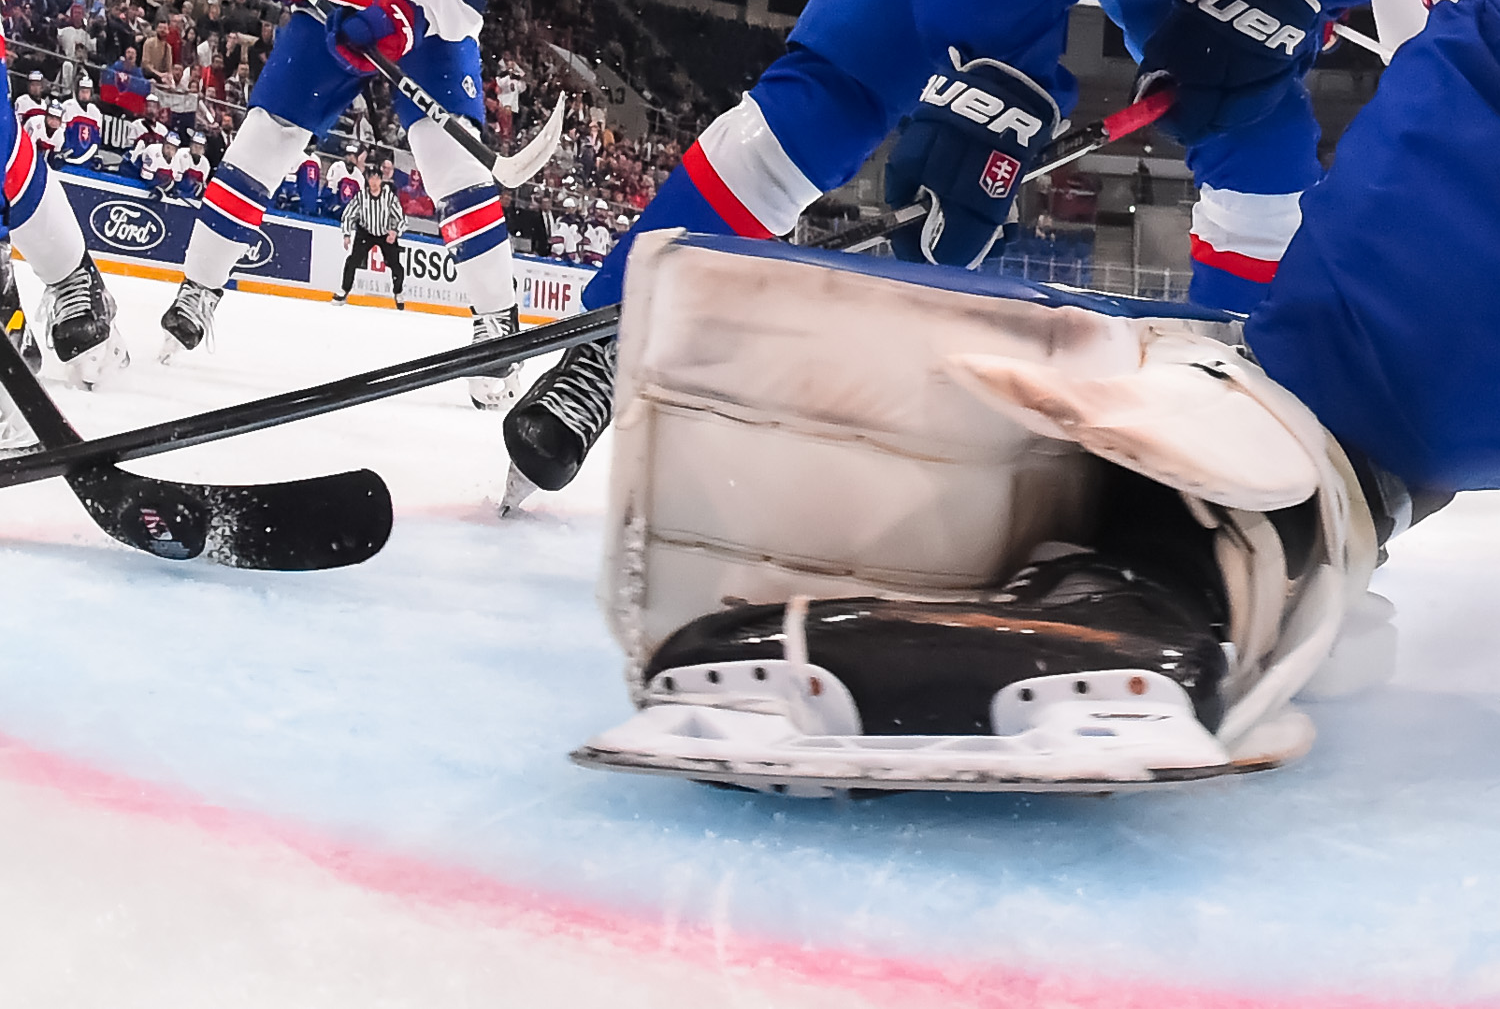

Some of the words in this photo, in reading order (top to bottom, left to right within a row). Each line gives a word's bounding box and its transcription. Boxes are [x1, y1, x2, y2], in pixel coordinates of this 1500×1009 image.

[399, 76, 451, 128] CCM
[104, 205, 158, 244] Ford
[533, 279, 572, 312] IIHF
